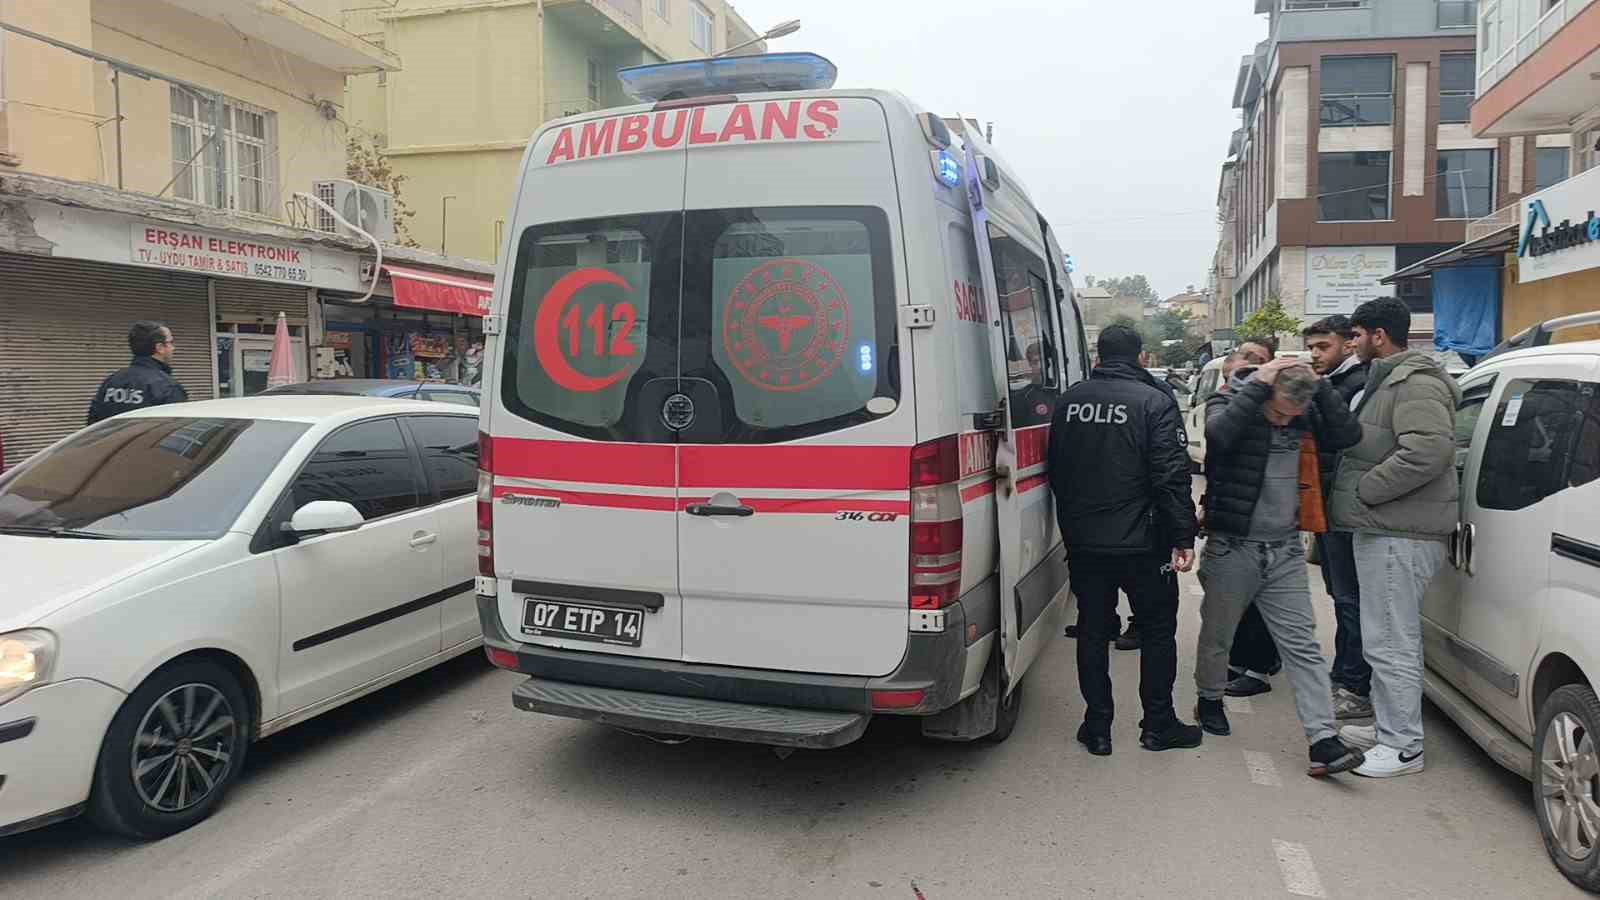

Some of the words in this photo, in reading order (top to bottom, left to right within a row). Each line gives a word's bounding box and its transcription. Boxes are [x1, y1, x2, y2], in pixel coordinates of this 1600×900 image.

[546, 99, 840, 165] AMBULANS
[138, 249, 151, 264] TV
[160, 251, 185, 266] UYDU
[145, 228, 203, 250] ERŞAN
[208, 237, 300, 263] ELEKTRONİK
[564, 301, 637, 358] 112
[835, 511, 864, 521] 316
[868, 512, 897, 522] CDI
[534, 603, 559, 627] 07
[564, 607, 605, 633] ETP
[615, 613, 637, 638] 14
